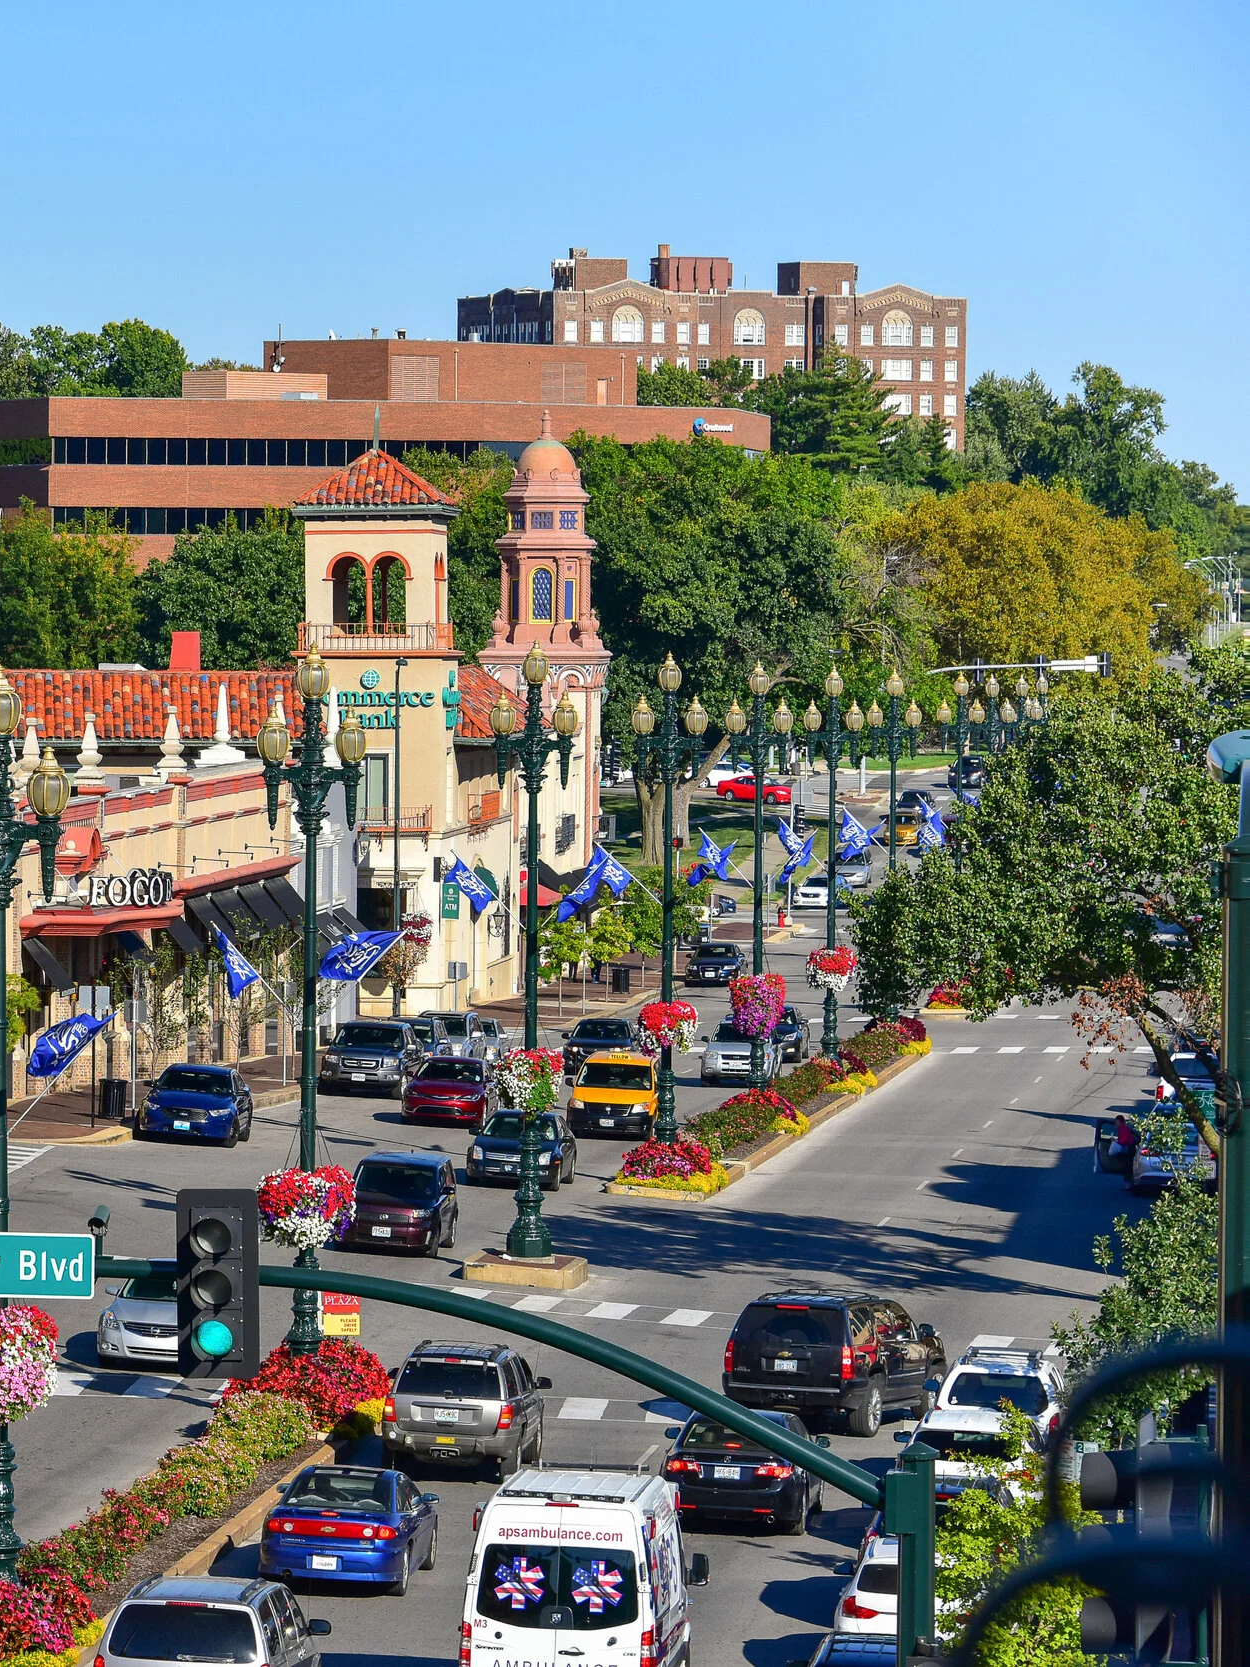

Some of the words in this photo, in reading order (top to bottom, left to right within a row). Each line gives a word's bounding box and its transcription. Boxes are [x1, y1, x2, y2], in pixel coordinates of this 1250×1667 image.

[322, 691, 435, 706] mmerce
[89, 876, 164, 907] FOGO
[19, 1249, 83, 1282] Blvd
[1077, 1444, 1083, 1452] 2
[498, 1526, 623, 1543] apsambulance.com
[473, 1619, 488, 1628] M3
[475, 1643, 504, 1651] SPRINTER
